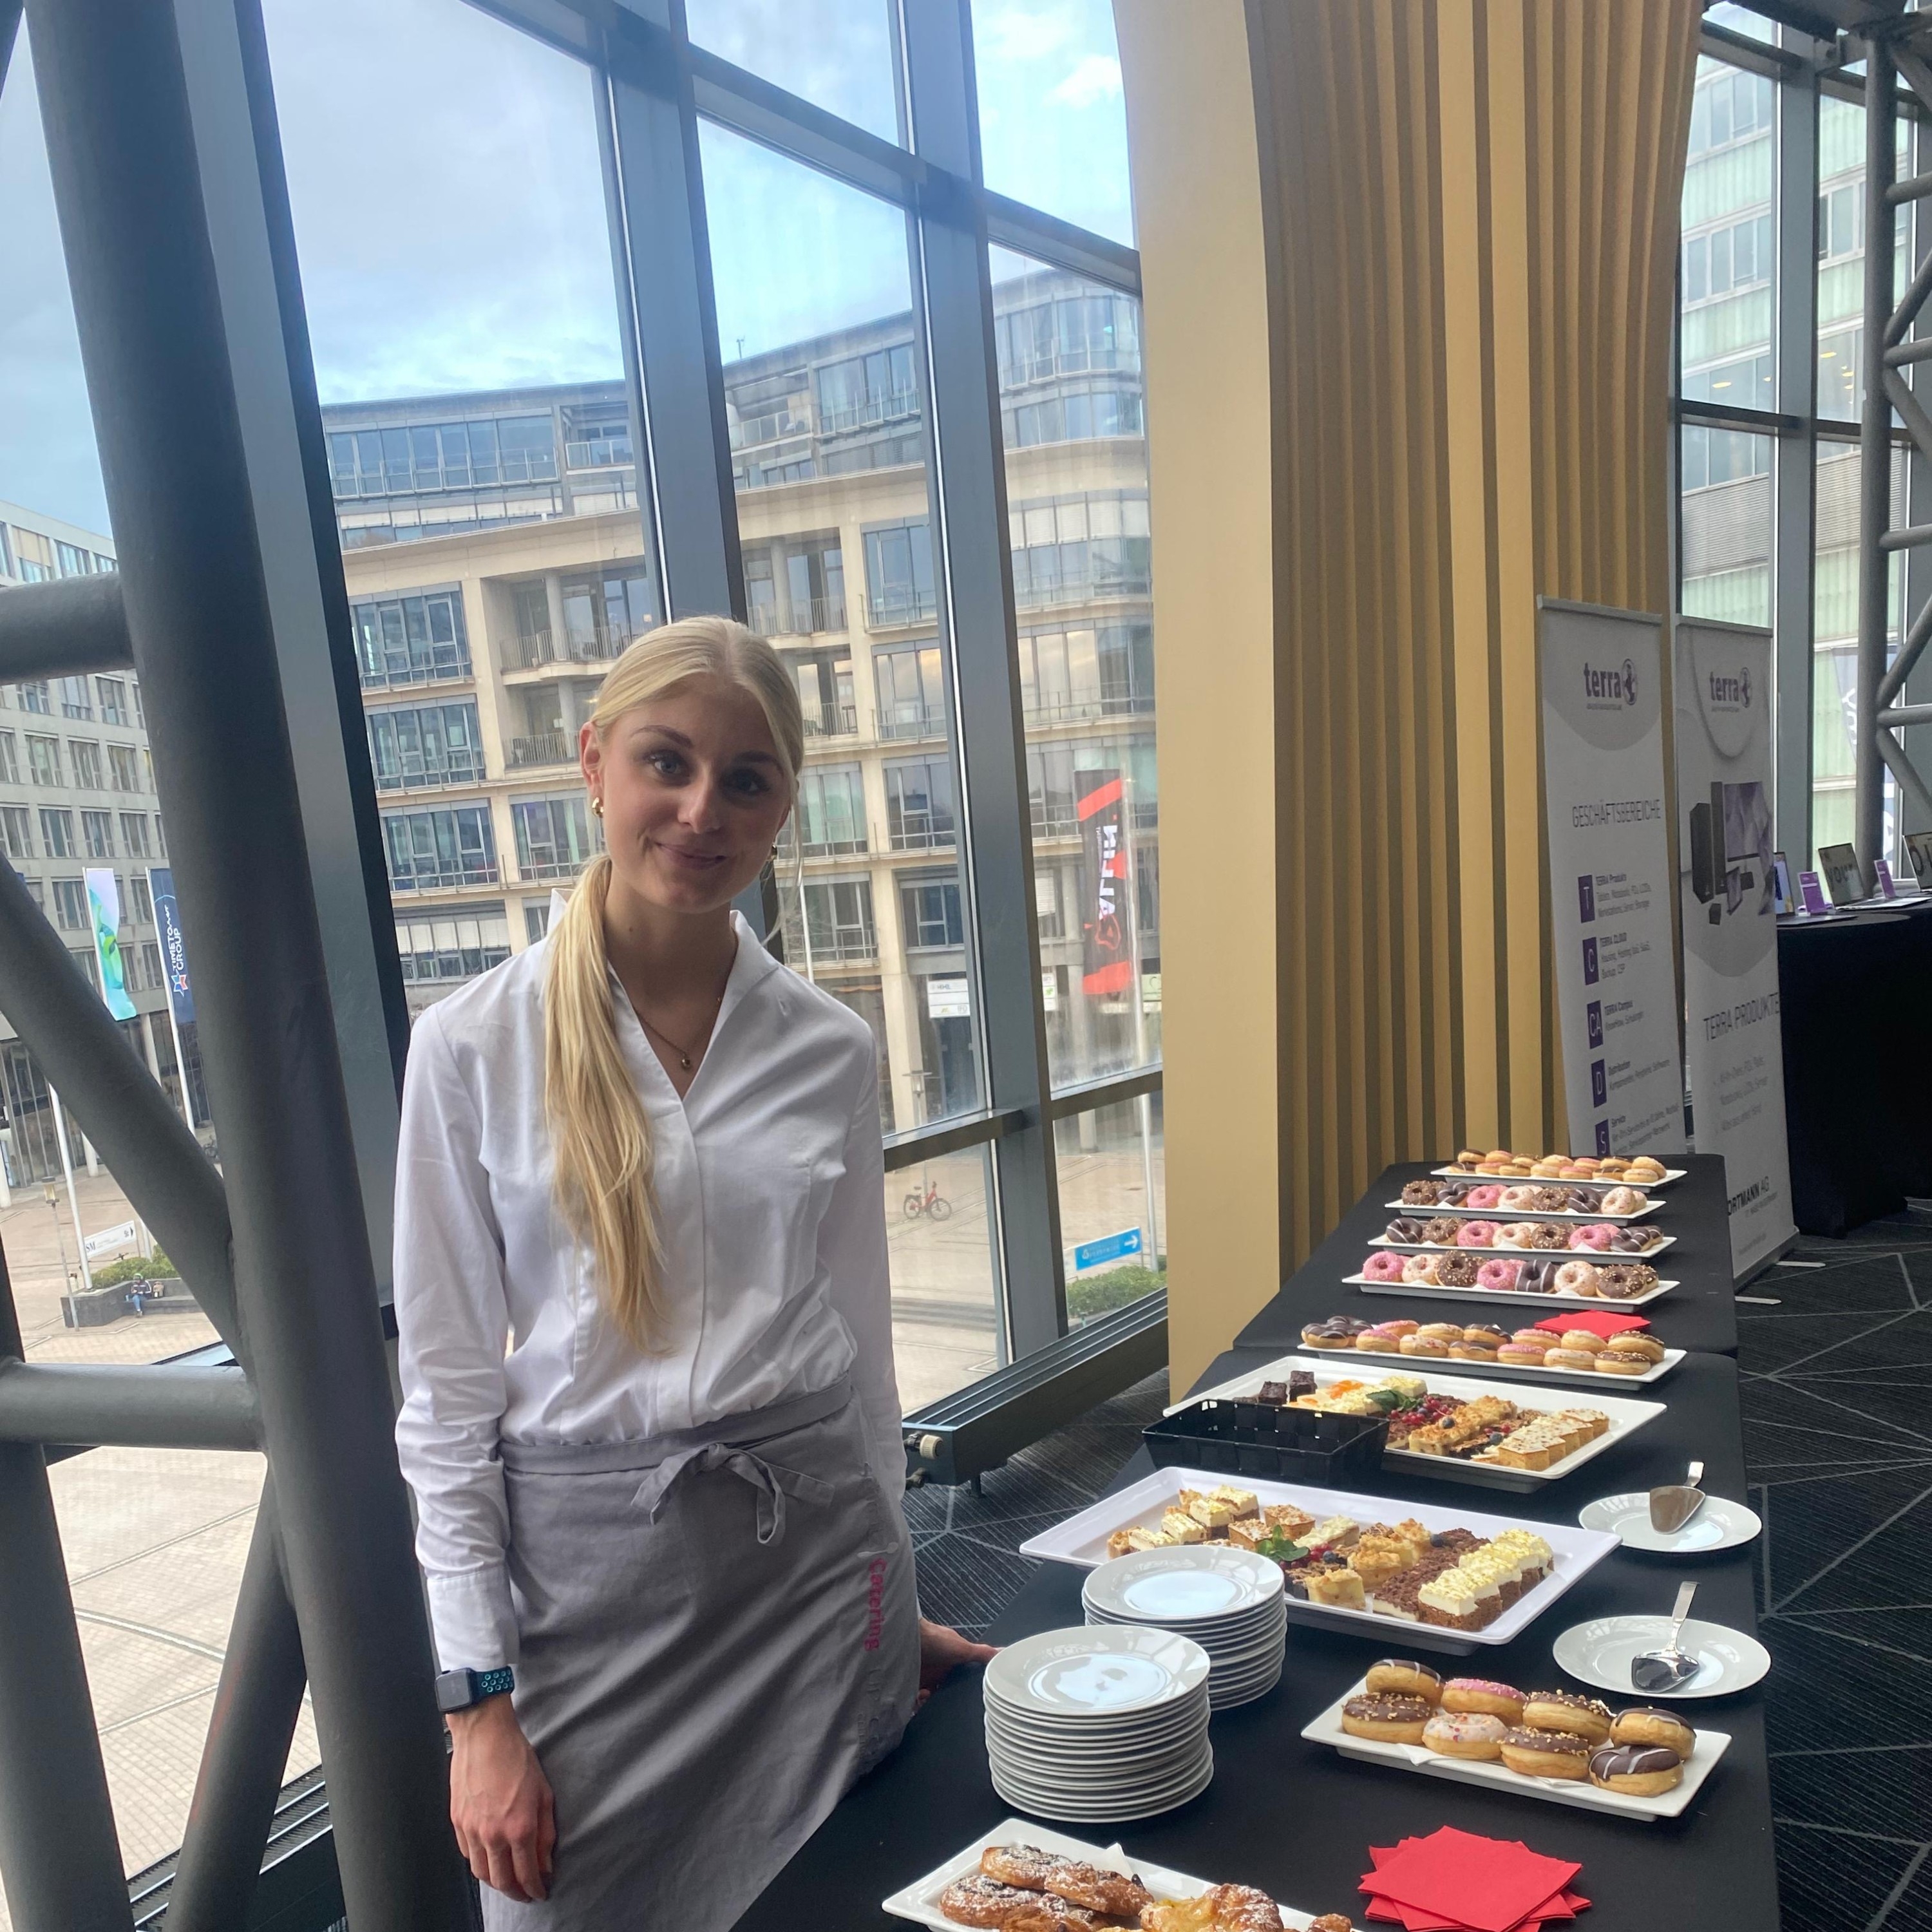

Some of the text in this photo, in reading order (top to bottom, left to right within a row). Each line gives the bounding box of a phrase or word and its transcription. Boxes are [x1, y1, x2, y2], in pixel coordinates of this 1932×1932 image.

[1584, 663, 1622, 698] terra
[1710, 671, 1739, 701] terra
[1573, 798, 1661, 828] GESCHÄFTSBEREICHE
[1583, 886, 1589, 911] T
[173, 927, 184, 971] GROUP
[1587, 948, 1595, 972] C
[1589, 1012, 1602, 1037] CA
[1703, 992, 1779, 1041] TERRA PRODUKTE
[1596, 1071, 1603, 1095] D
[1600, 1132, 1607, 1153] S
[1727, 1182, 1759, 1217] ORTMANN
[864, 1558, 887, 1651] Catering
